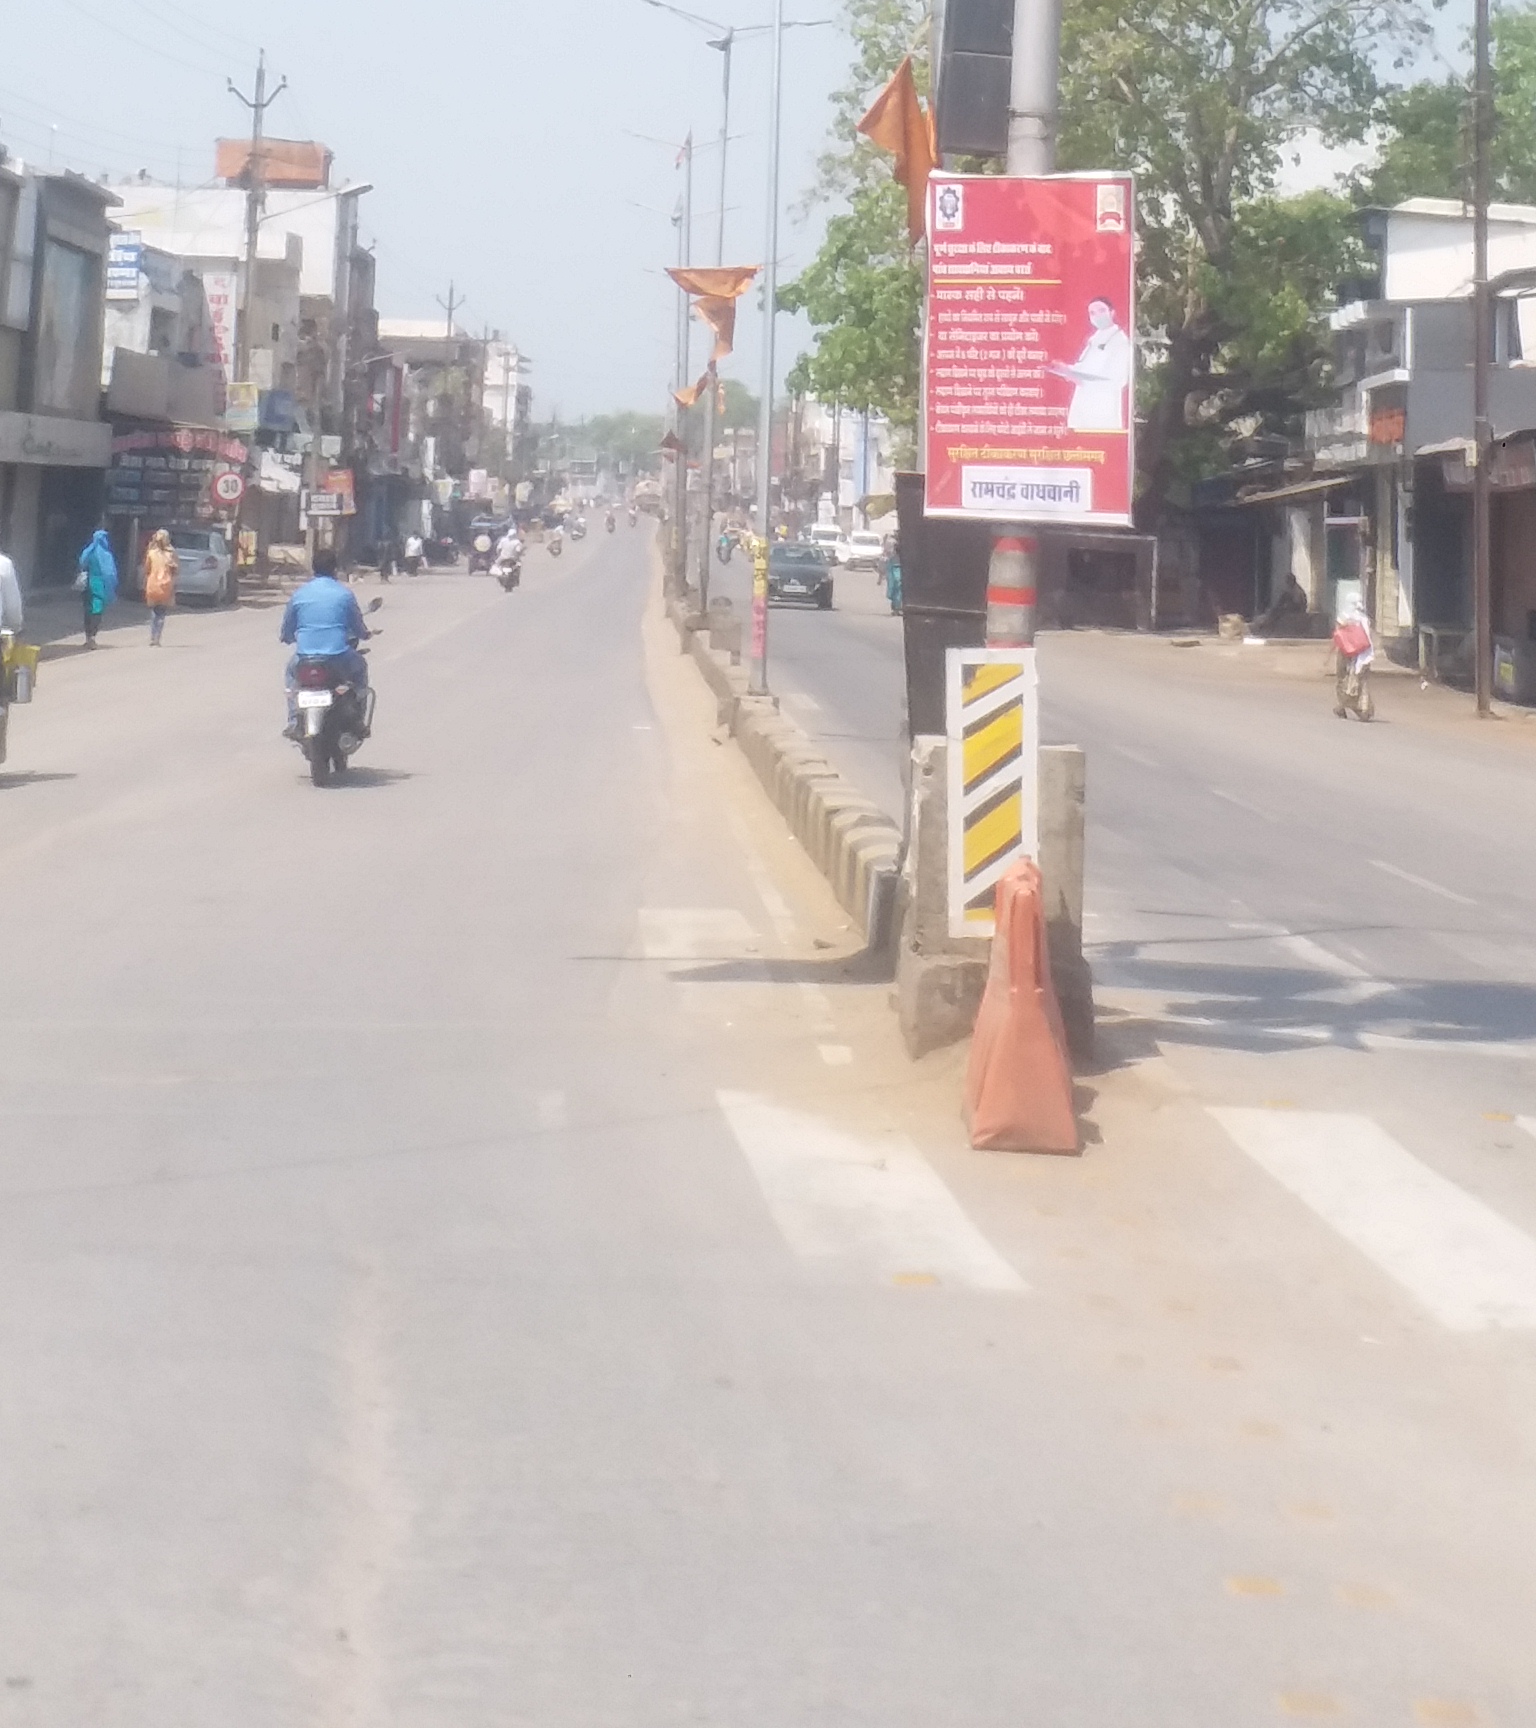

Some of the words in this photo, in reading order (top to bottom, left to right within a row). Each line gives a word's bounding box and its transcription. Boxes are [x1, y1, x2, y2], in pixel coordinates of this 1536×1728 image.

[936, 289, 962, 301] मास्क
[965, 286, 984, 302] सही
[986, 285, 996, 301] से
[222, 479, 238, 494] 30
[1020, 479, 1081, 504] वाधवानी
